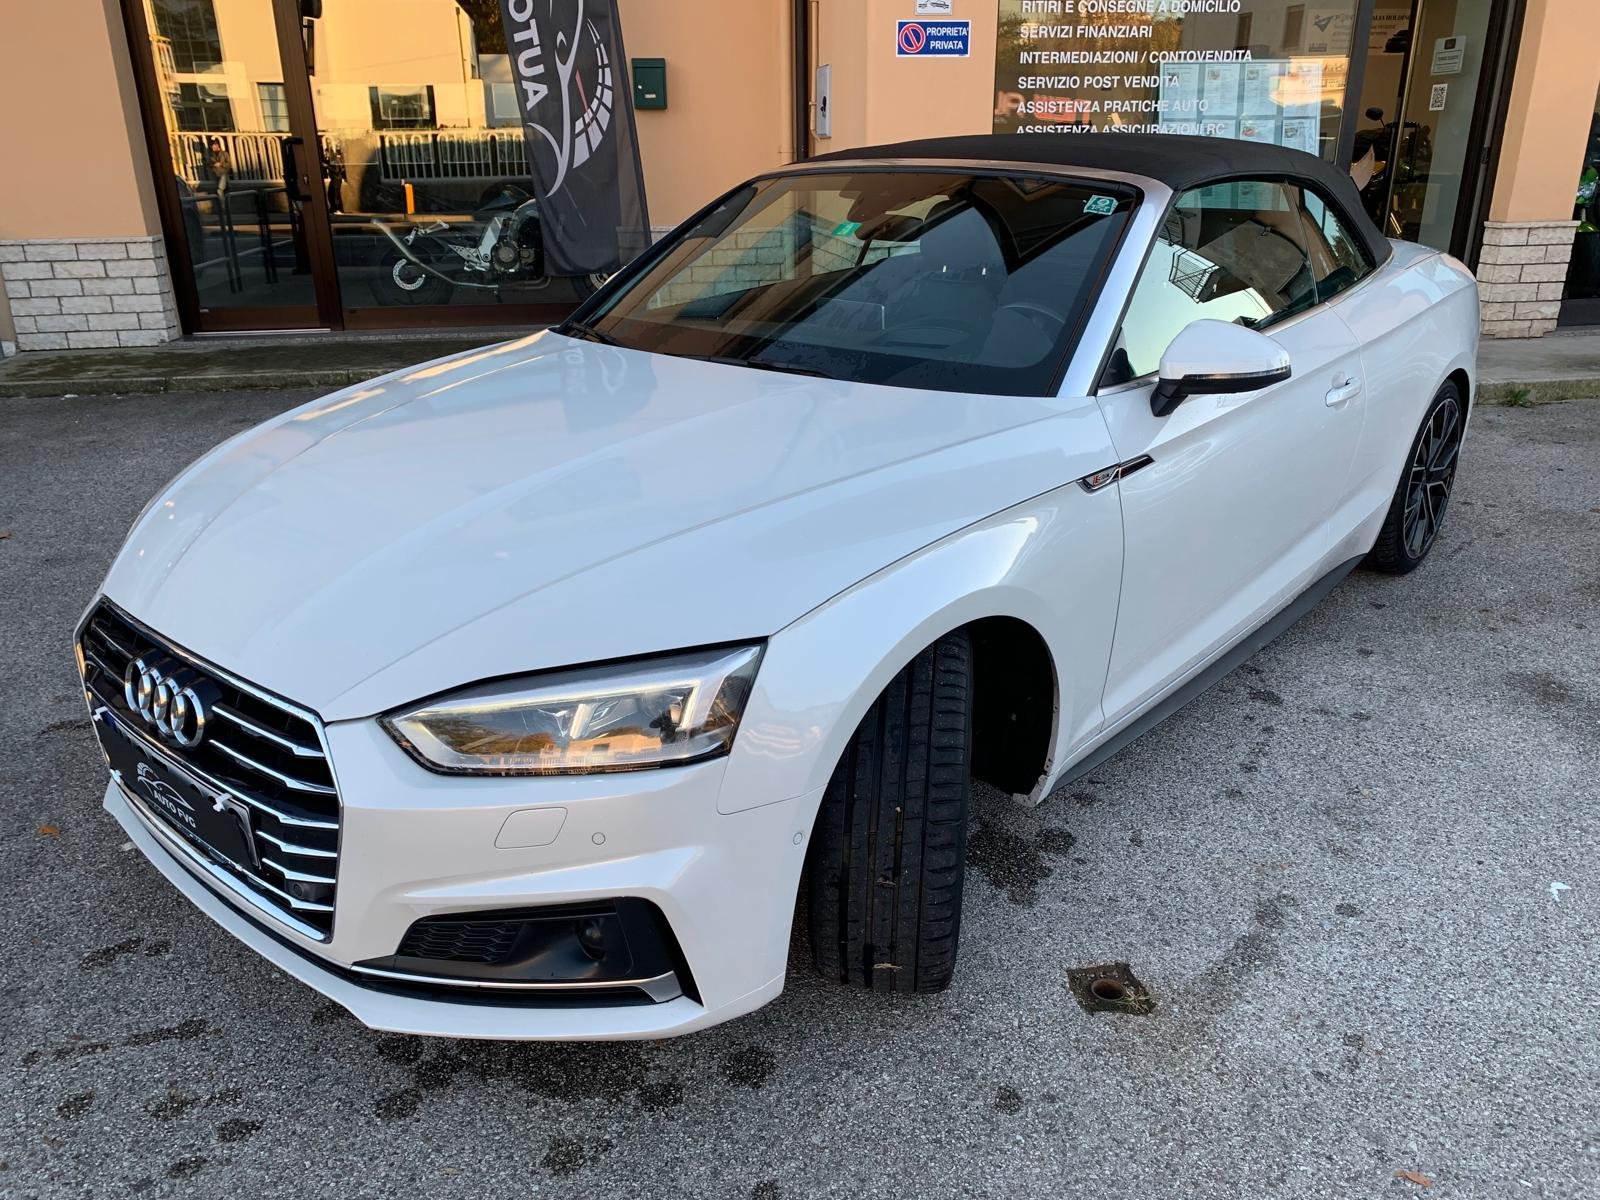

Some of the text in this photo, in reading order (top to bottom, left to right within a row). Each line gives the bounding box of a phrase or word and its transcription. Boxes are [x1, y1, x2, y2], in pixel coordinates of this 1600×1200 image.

[1022, 0, 1241, 13] RITIRI E CONSEGNE A DOMICILIO
[926, 27, 969, 36] PROPRIETA'
[1020, 25, 1153, 38] SERVIZI FINANZIARI
[930, 40, 964, 50] PRIVATA
[1020, 50, 1252, 64] INTERMEDIAZIONI / CONTOVENDITA
[1018, 75, 1180, 89] SERVIZIO POST VENDITA
[1016, 99, 1209, 113] ASSISTENZA PRATICHE AUTO
[1207, 123, 1226, 136] RC
[154, 790, 177, 814] AUTO
